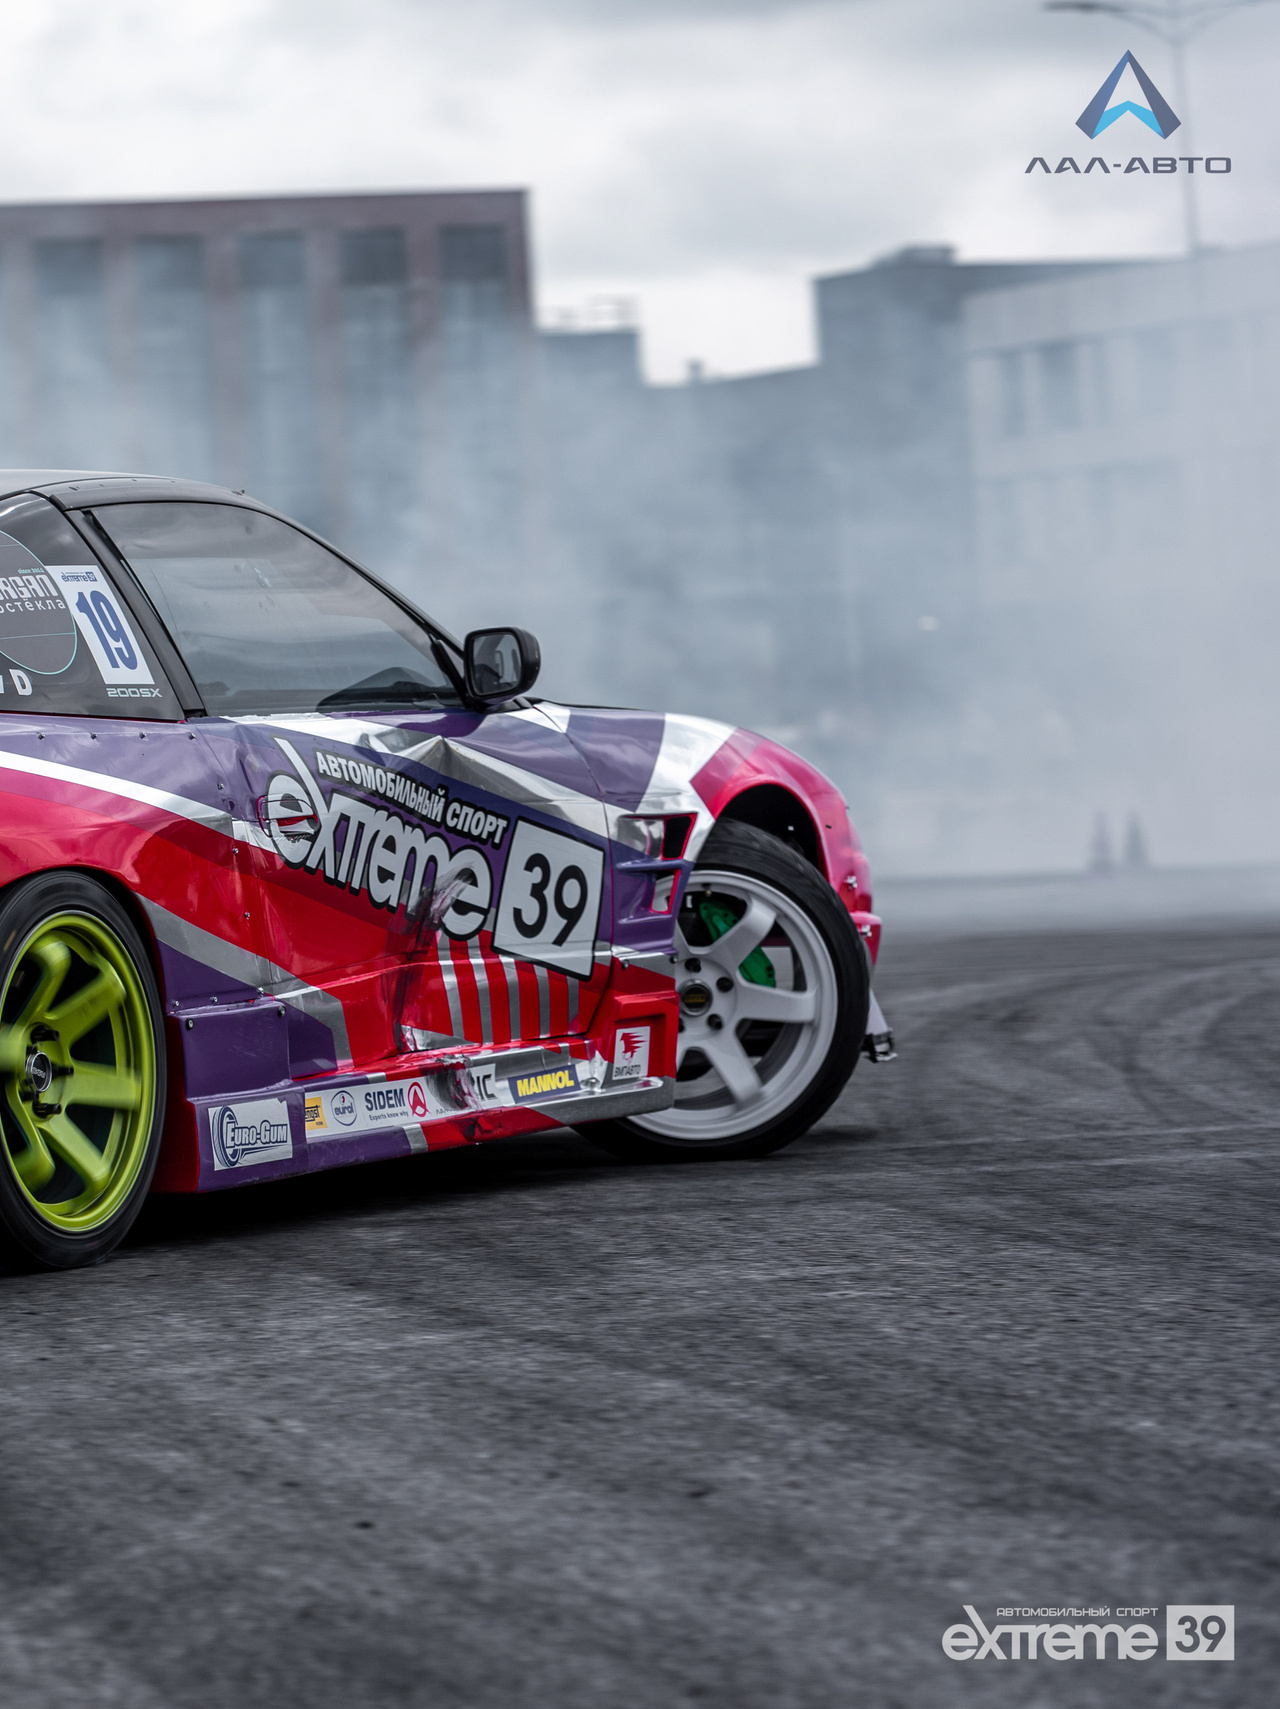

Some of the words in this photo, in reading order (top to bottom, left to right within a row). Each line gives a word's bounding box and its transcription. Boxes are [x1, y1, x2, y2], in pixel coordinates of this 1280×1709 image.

[76, 590, 138, 670] 19
[8, 669, 33, 696] D
[106, 687, 163, 698] 200SX
[316, 751, 446, 822] АВТОМОБИЛЬНЫЙ
[445, 803, 508, 844] СПОРТ
[513, 853, 588, 947] 39
[517, 1070, 574, 1097] MANNOL
[365, 1088, 406, 1112] SIDEM
